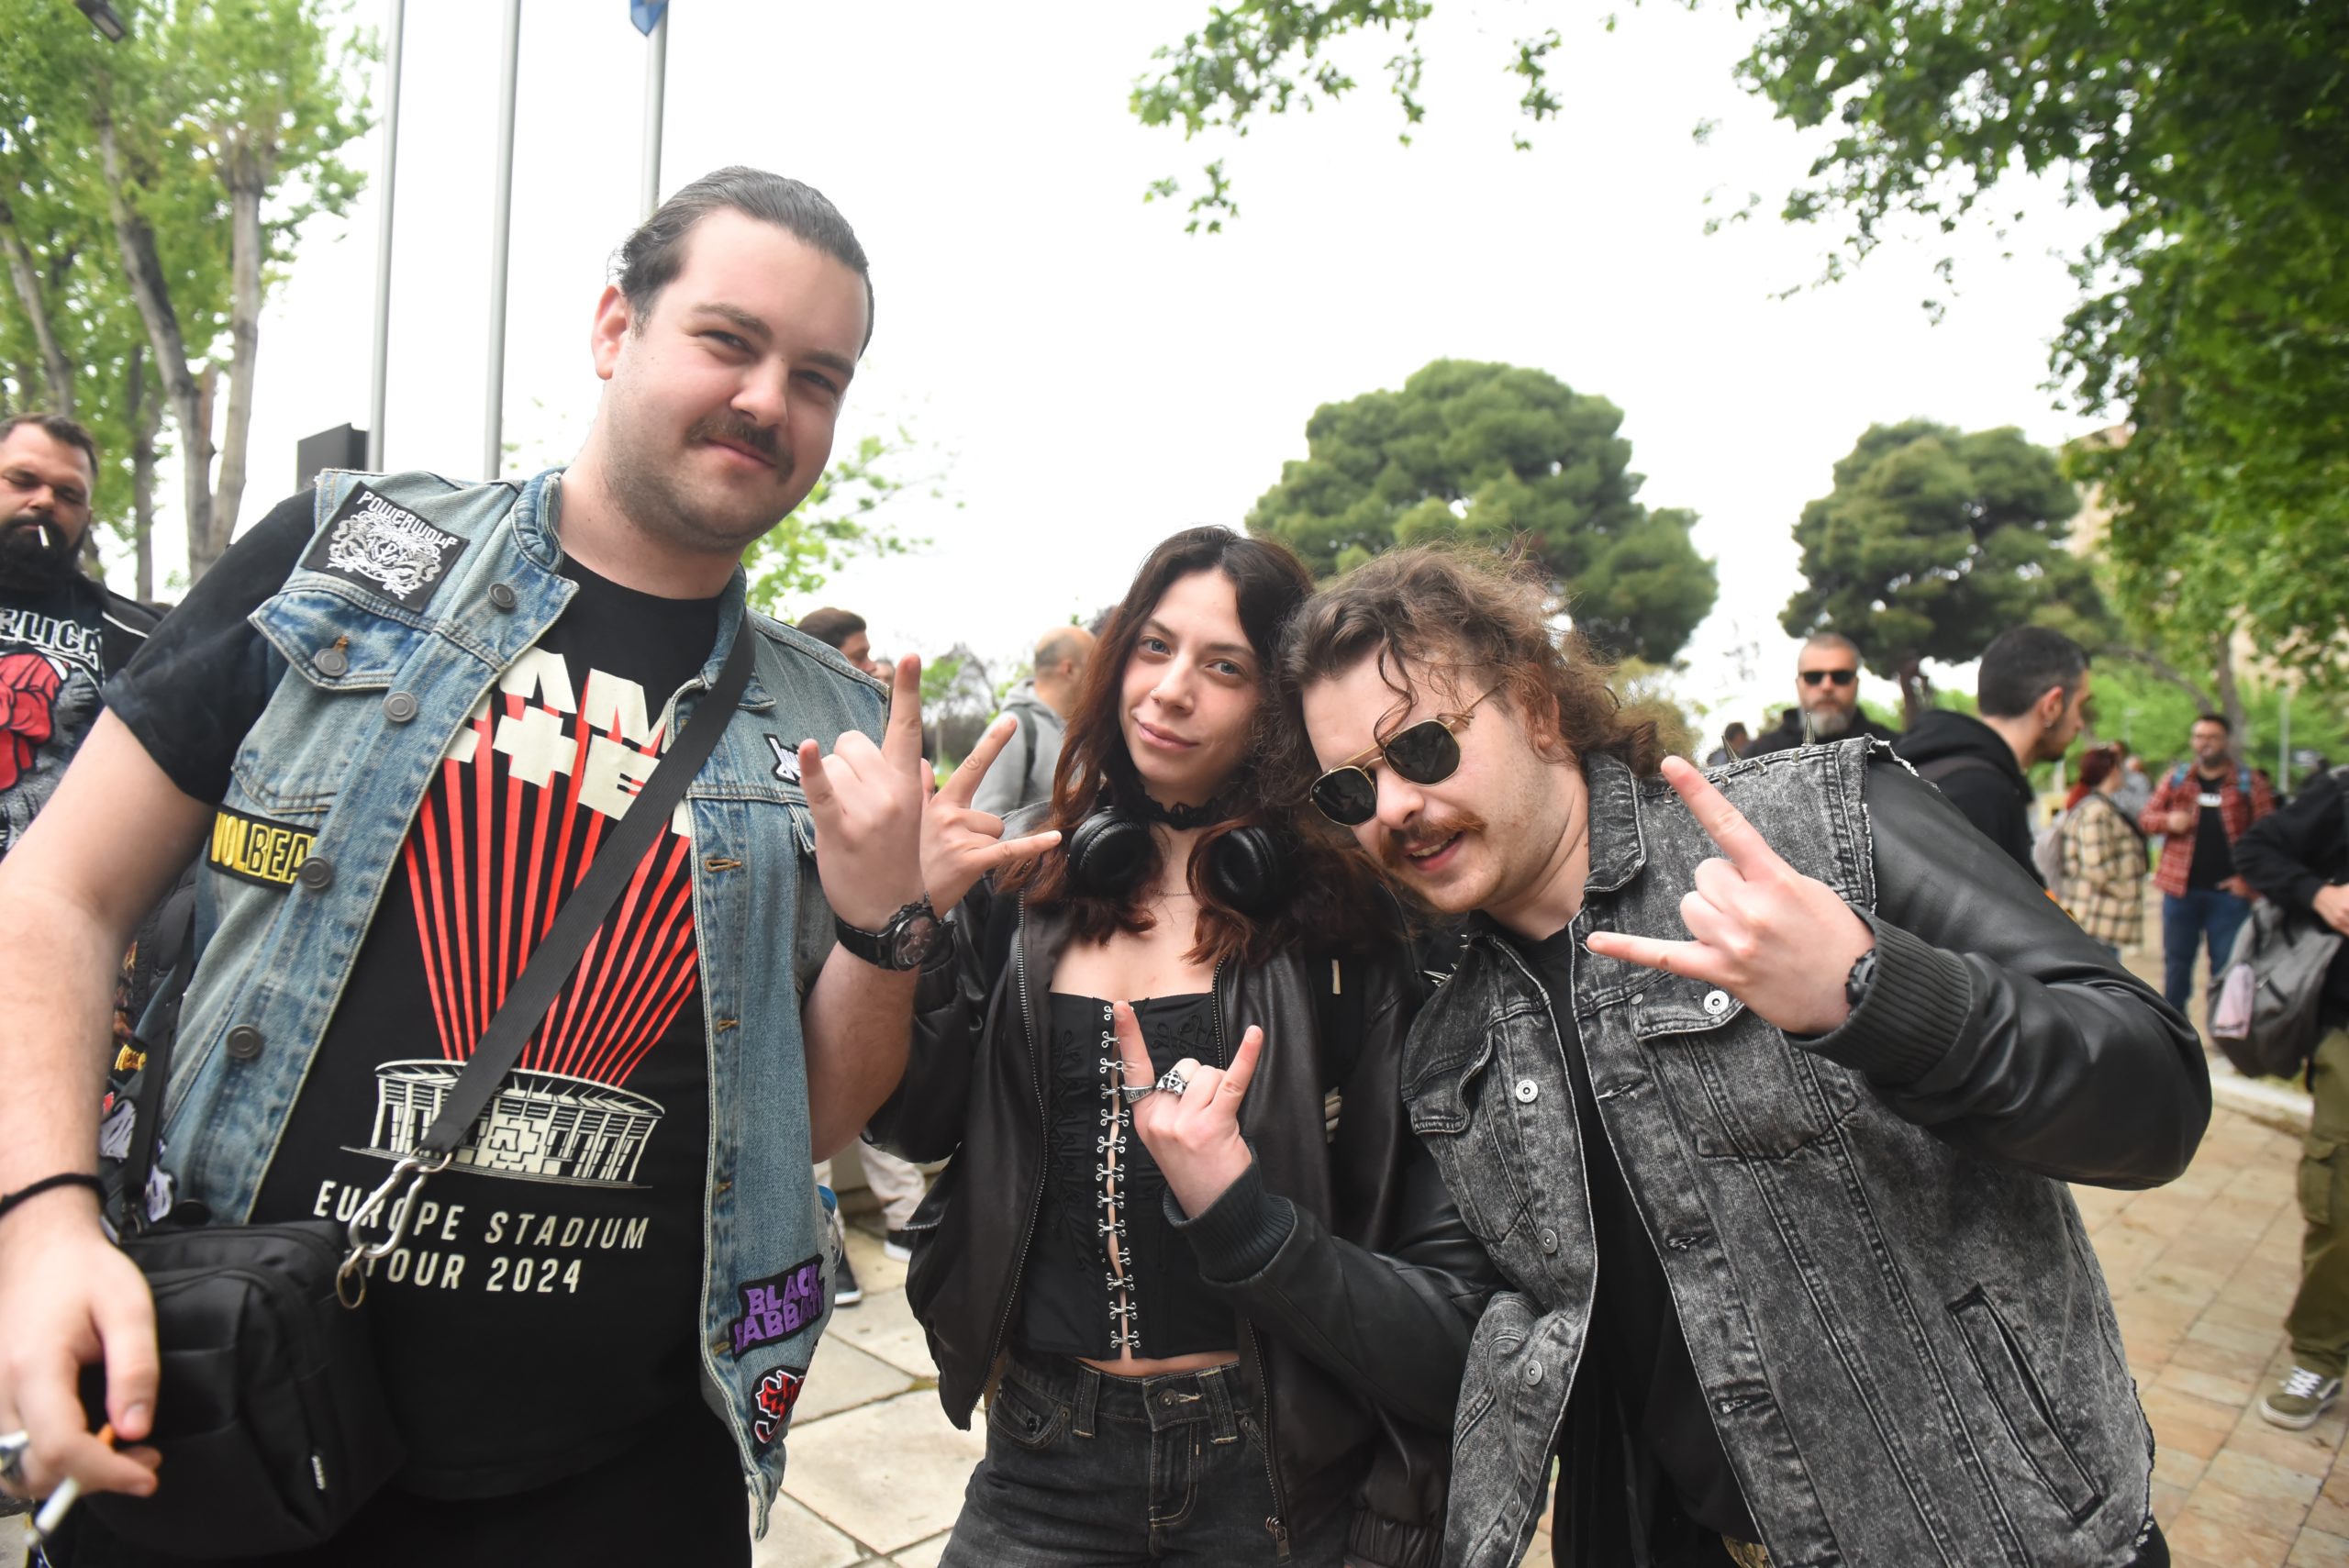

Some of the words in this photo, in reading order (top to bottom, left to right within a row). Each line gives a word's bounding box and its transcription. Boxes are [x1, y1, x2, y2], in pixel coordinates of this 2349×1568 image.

[357, 491, 458, 549] POWERWOLF
[211, 812, 317, 884] VOLBEA
[313, 1180, 464, 1240] EUROPE
[484, 1211, 650, 1249] STADIUM
[486, 1256, 582, 1294] 2024
[745, 1263, 819, 1317] BLACK
